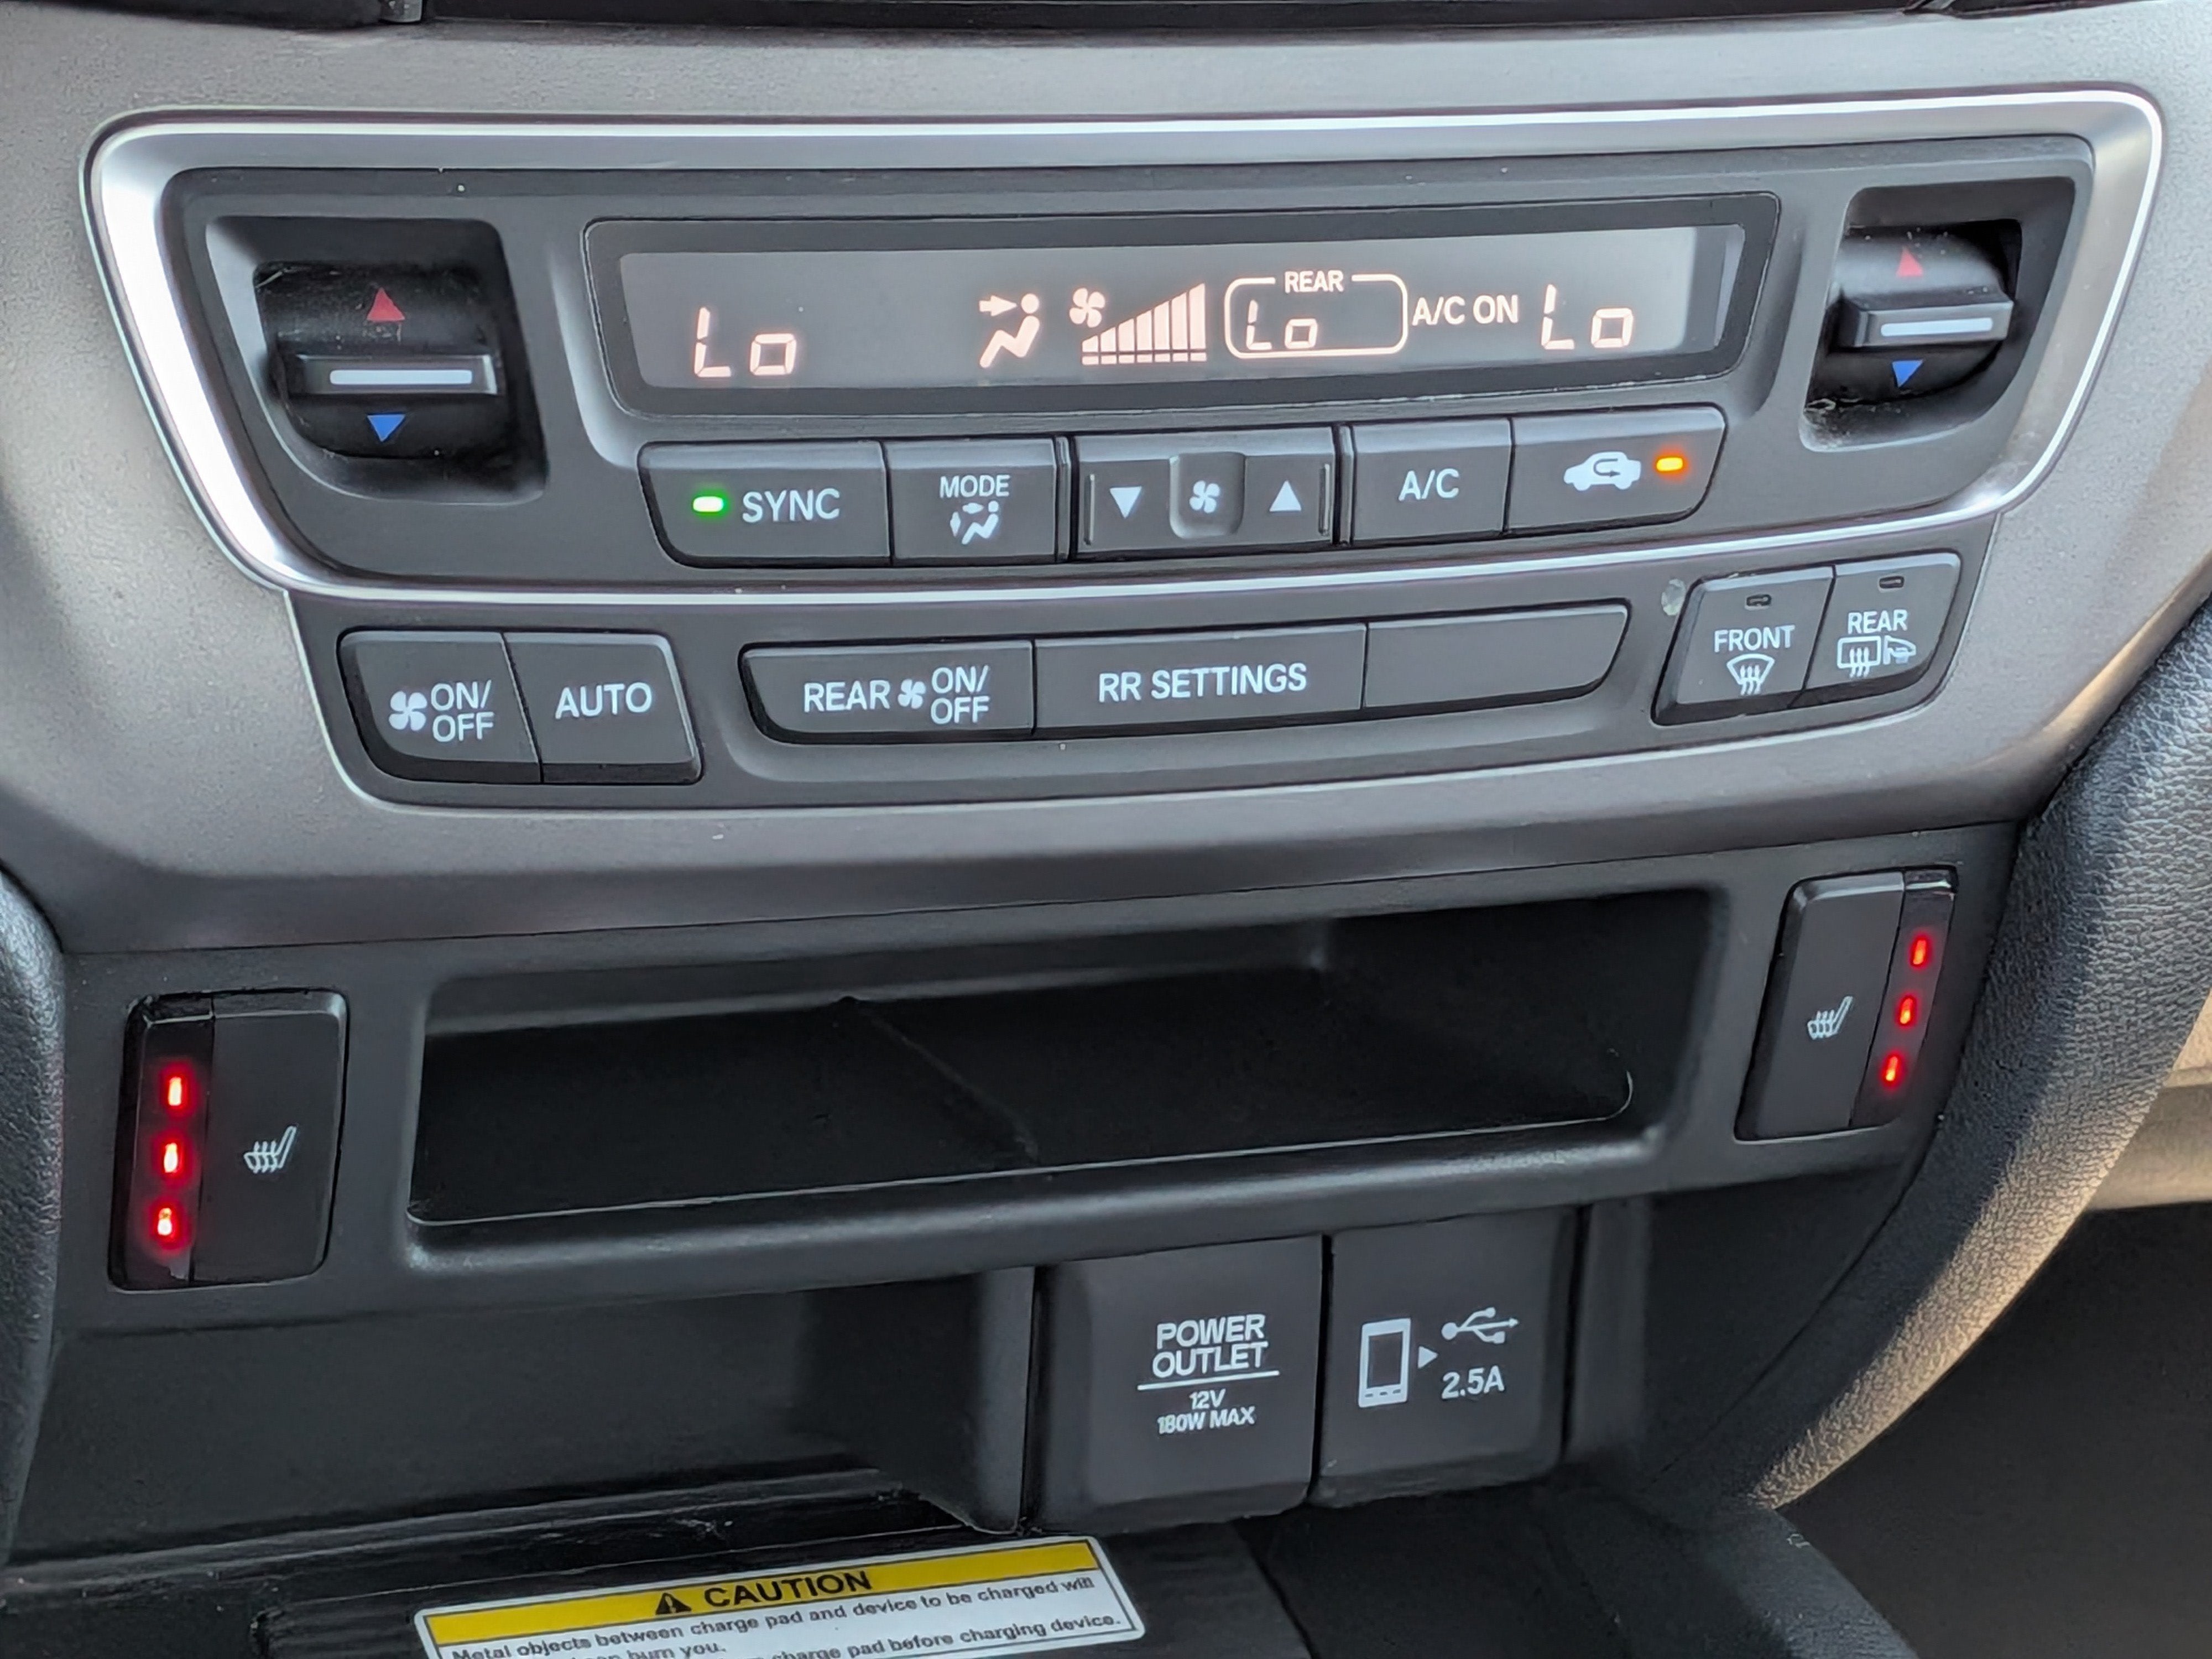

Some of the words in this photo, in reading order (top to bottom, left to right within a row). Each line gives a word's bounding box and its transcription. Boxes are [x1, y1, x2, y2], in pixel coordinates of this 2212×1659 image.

[1285, 270, 1344, 293] REAR
[1245, 300, 1318, 351] Lo
[1412, 296, 1465, 326] A/C
[1473, 295, 1519, 324] ON
[1541, 284, 1634, 350] Lo
[694, 307, 797, 378] Lo
[940, 474, 1010, 498] MODE
[1399, 468, 1459, 501] A/C
[742, 488, 839, 523] SYNC
[1848, 609, 1908, 634] REAR
[1714, 624, 1796, 653] FRONT
[931, 665, 989, 693] ON/
[1099, 671, 1141, 702] RR
[1151, 662, 1307, 699] SETTINGS
[431, 680, 492, 711] ON/
[555, 682, 653, 719] AUTO
[804, 680, 890, 712] REAR
[931, 696, 990, 724] OFF
[432, 712, 494, 742] OFF
[1156, 1313, 1266, 1349] POWER
[1152, 1341, 1269, 1378] OUTLET
[1442, 1365, 1505, 1399] 2.5A
[1188, 1388, 1227, 1410] 12V
[1156, 1411, 1207, 1434] 180W
[1208, 1405, 1256, 1429] MAX
[703, 1571, 873, 1608] CAUTION
[451, 1644, 512, 1659] Metal
[516, 1637, 592, 1656] objects
[594, 1626, 685, 1647] between
[690, 1618, 759, 1634] charge
[764, 1610, 805, 1630] pad
[808, 1604, 847, 1621] and
[852, 1598, 918, 1616] device
[920, 1594, 941, 1608] to
[946, 1591, 973, 1605] be
[977, 1580, 1059, 1601] charged
[1060, 1576, 1095, 1592] will
[679, 1642, 727, 1659] you.
[847, 1639, 885, 1658] pad
[887, 1634, 954, 1652] before
[959, 1620, 1047, 1644] charging
[1050, 1614, 1121, 1632] device.
